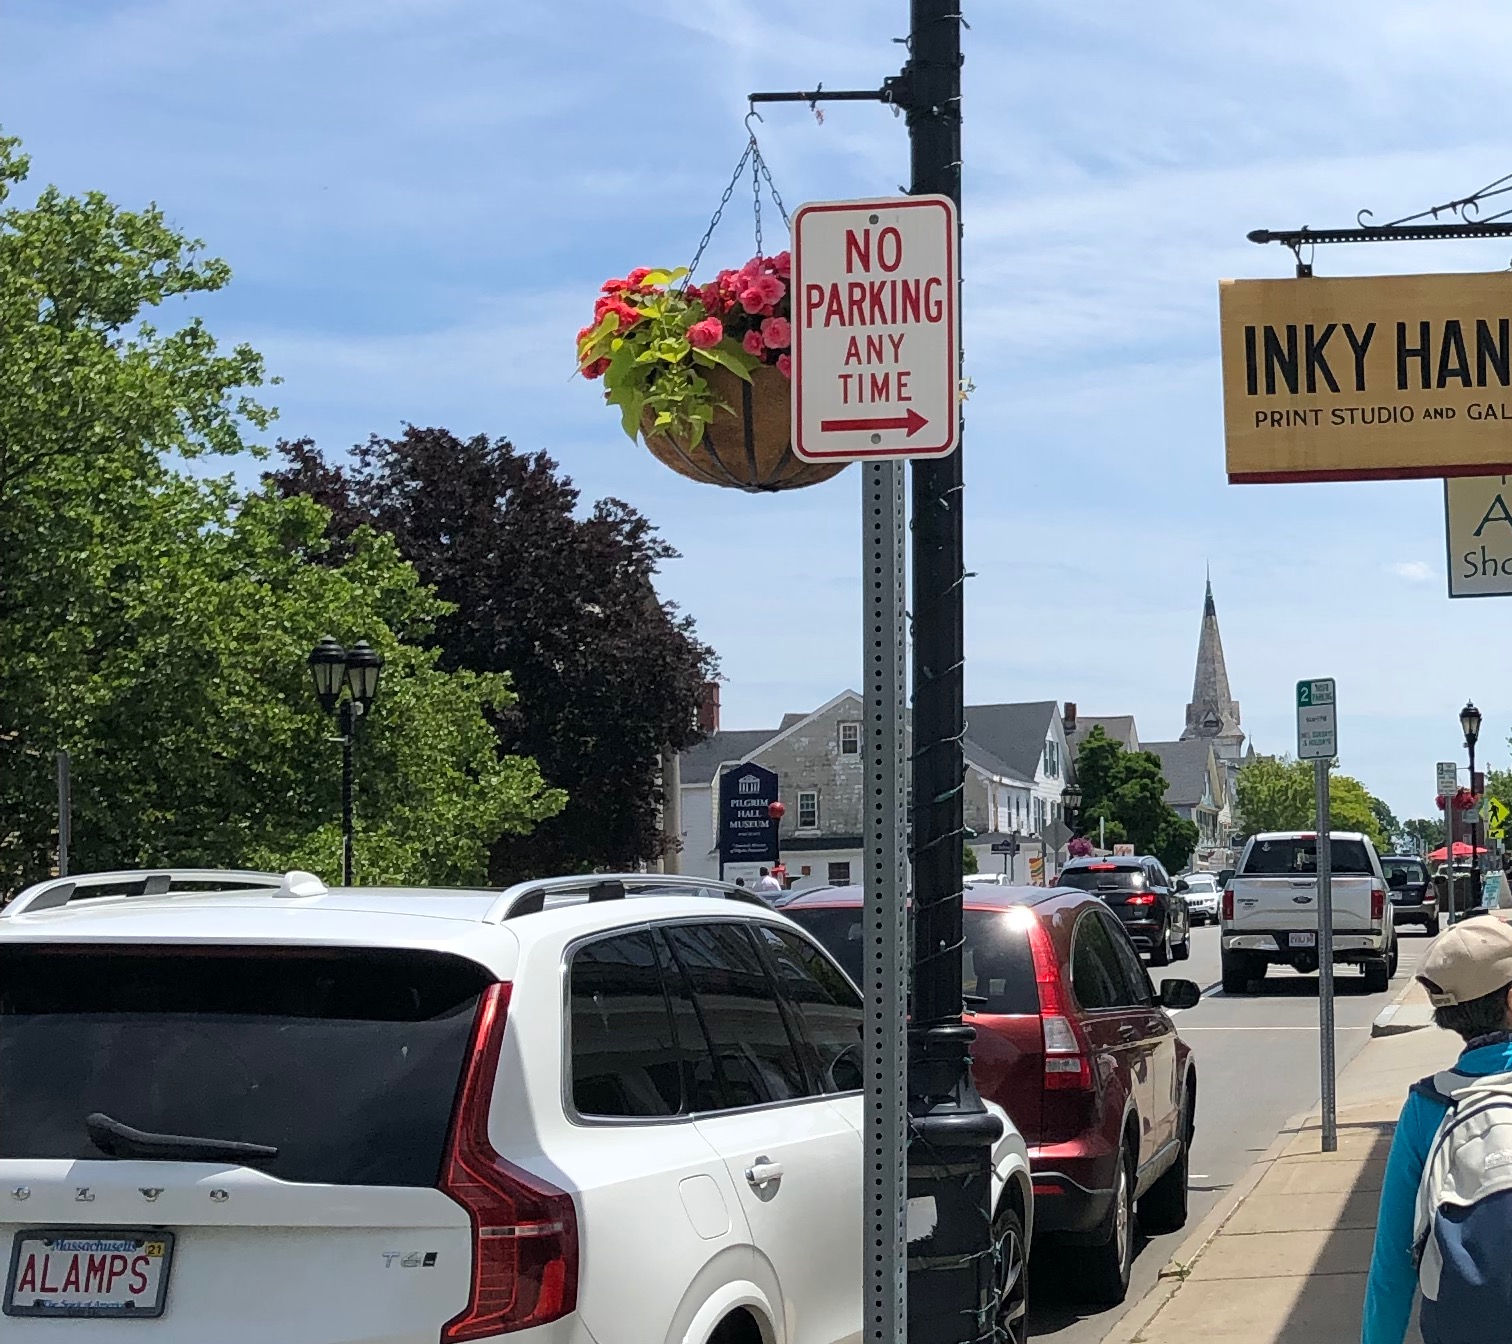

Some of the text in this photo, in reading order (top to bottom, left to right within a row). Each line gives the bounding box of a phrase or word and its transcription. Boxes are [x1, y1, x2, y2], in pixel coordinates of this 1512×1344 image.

[845, 226, 903, 274] NO
[805, 276, 944, 329] PARKING
[844, 333, 906, 367] ANY
[1244, 322, 1377, 396] INKY
[838, 370, 913, 405] TIME
[1254, 408, 1324, 429] PRINT
[1330, 405, 1415, 427] STUDIO
[1422, 406, 1457, 421] AND
[1300, 686, 1309, 702] 2
[730, 798, 769, 808] PILGRIM
[729, 819, 770, 829] MUSEUM
[10, 1186, 231, 1204] OLVO
[148, 1245, 162, 1255] 21
[17, 1253, 150, 1294] ALAMPS
